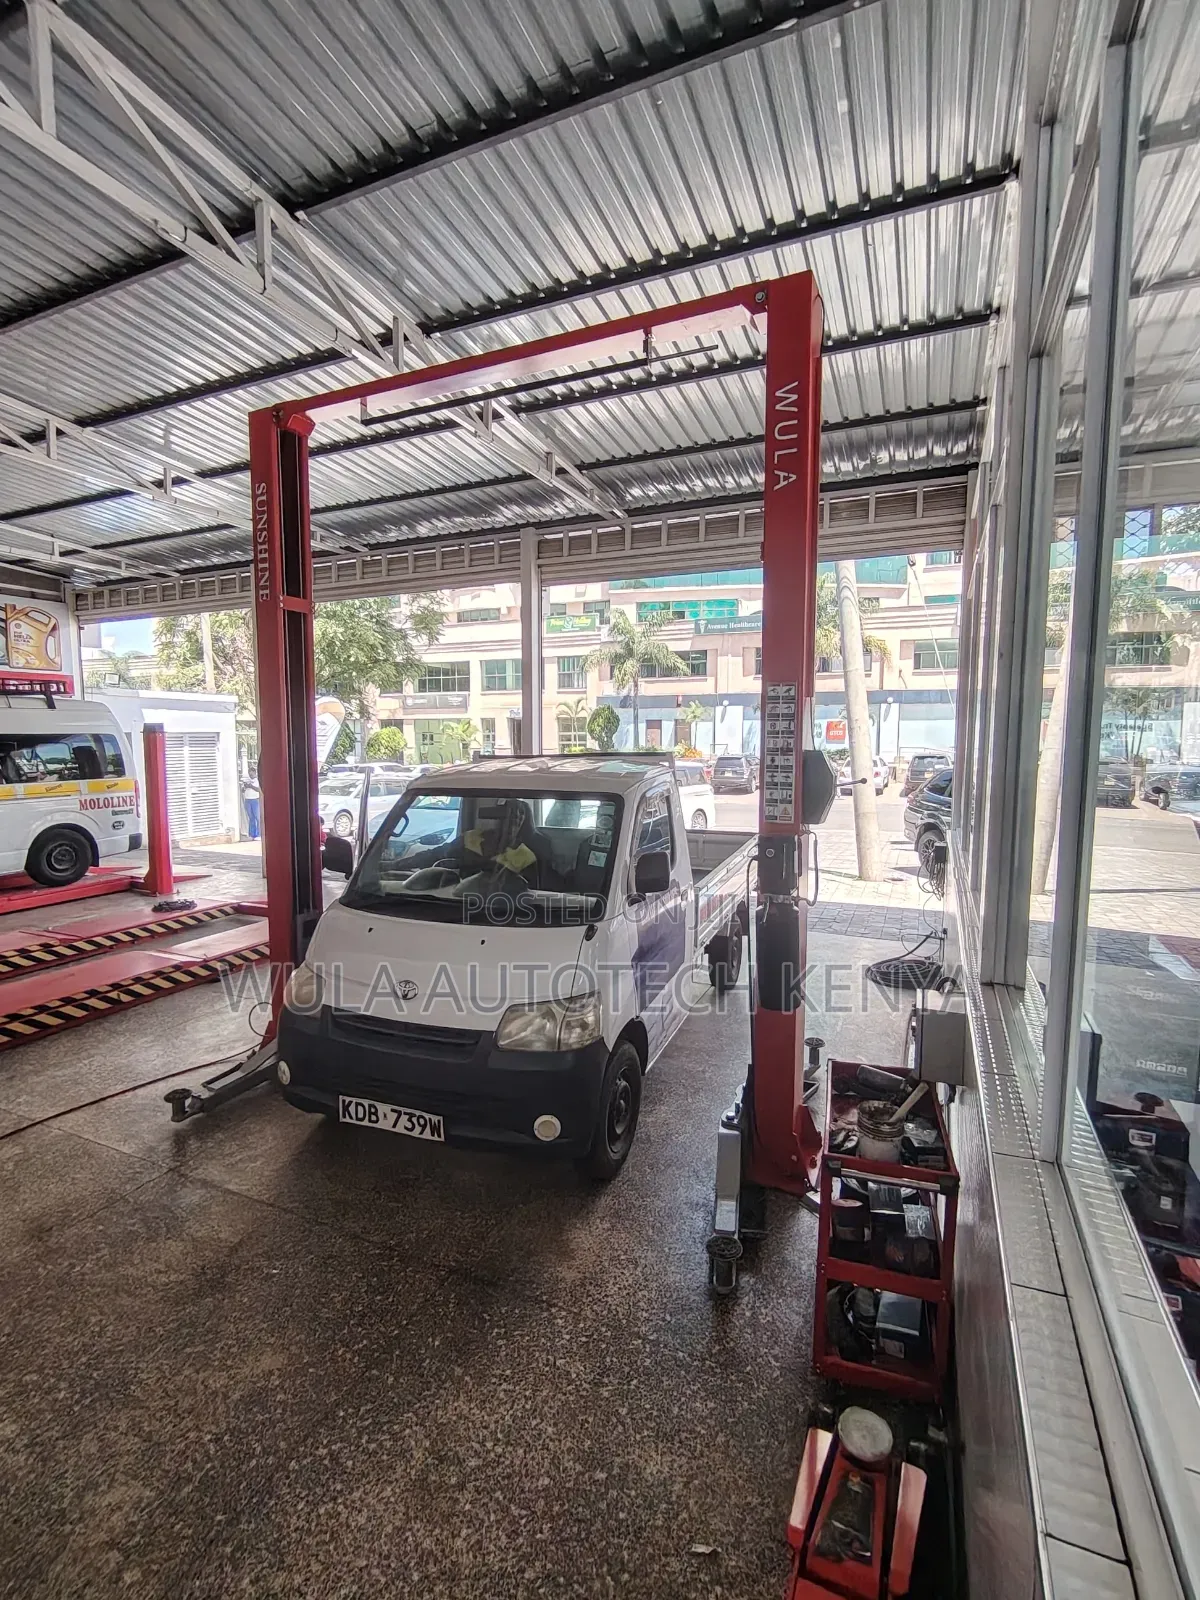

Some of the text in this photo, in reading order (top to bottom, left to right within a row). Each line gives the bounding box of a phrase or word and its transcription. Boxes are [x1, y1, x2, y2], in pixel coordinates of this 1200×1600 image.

[773, 381, 799, 491] WULA
[255, 482, 270, 602] SUNSHINE
[79, 796, 135, 811] MOLOLINE
[341, 1099, 442, 1139] KDB 739W
